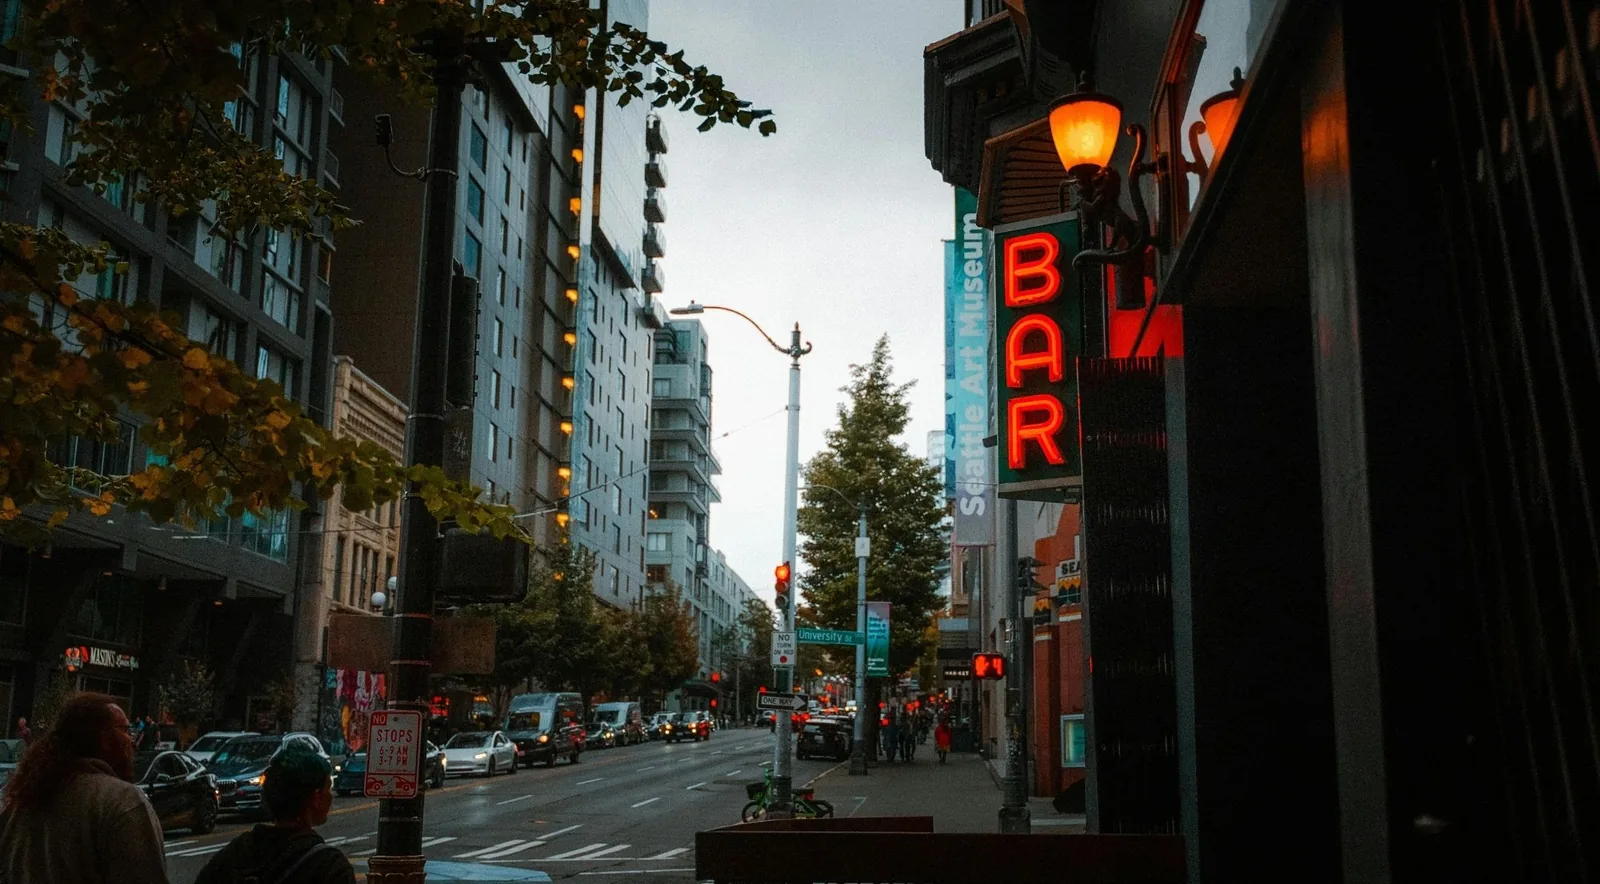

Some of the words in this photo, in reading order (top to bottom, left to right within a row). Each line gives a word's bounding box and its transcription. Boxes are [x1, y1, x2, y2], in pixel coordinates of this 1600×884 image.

[960, 212, 984, 337] Museum
[1004, 232, 1066, 470] BAR
[960, 346, 984, 397] Art
[960, 404, 986, 516] Seattle
[799, 629, 843, 642] University
[763, 696, 777, 704] ONE
[372, 714, 386, 724] NO
[376, 729, 412, 743] STOPS
[379, 746, 394, 755] 6-9
[396, 746, 408, 755] AM
[379, 756, 393, 766] 3-7
[396, 756, 408, 766] PM
